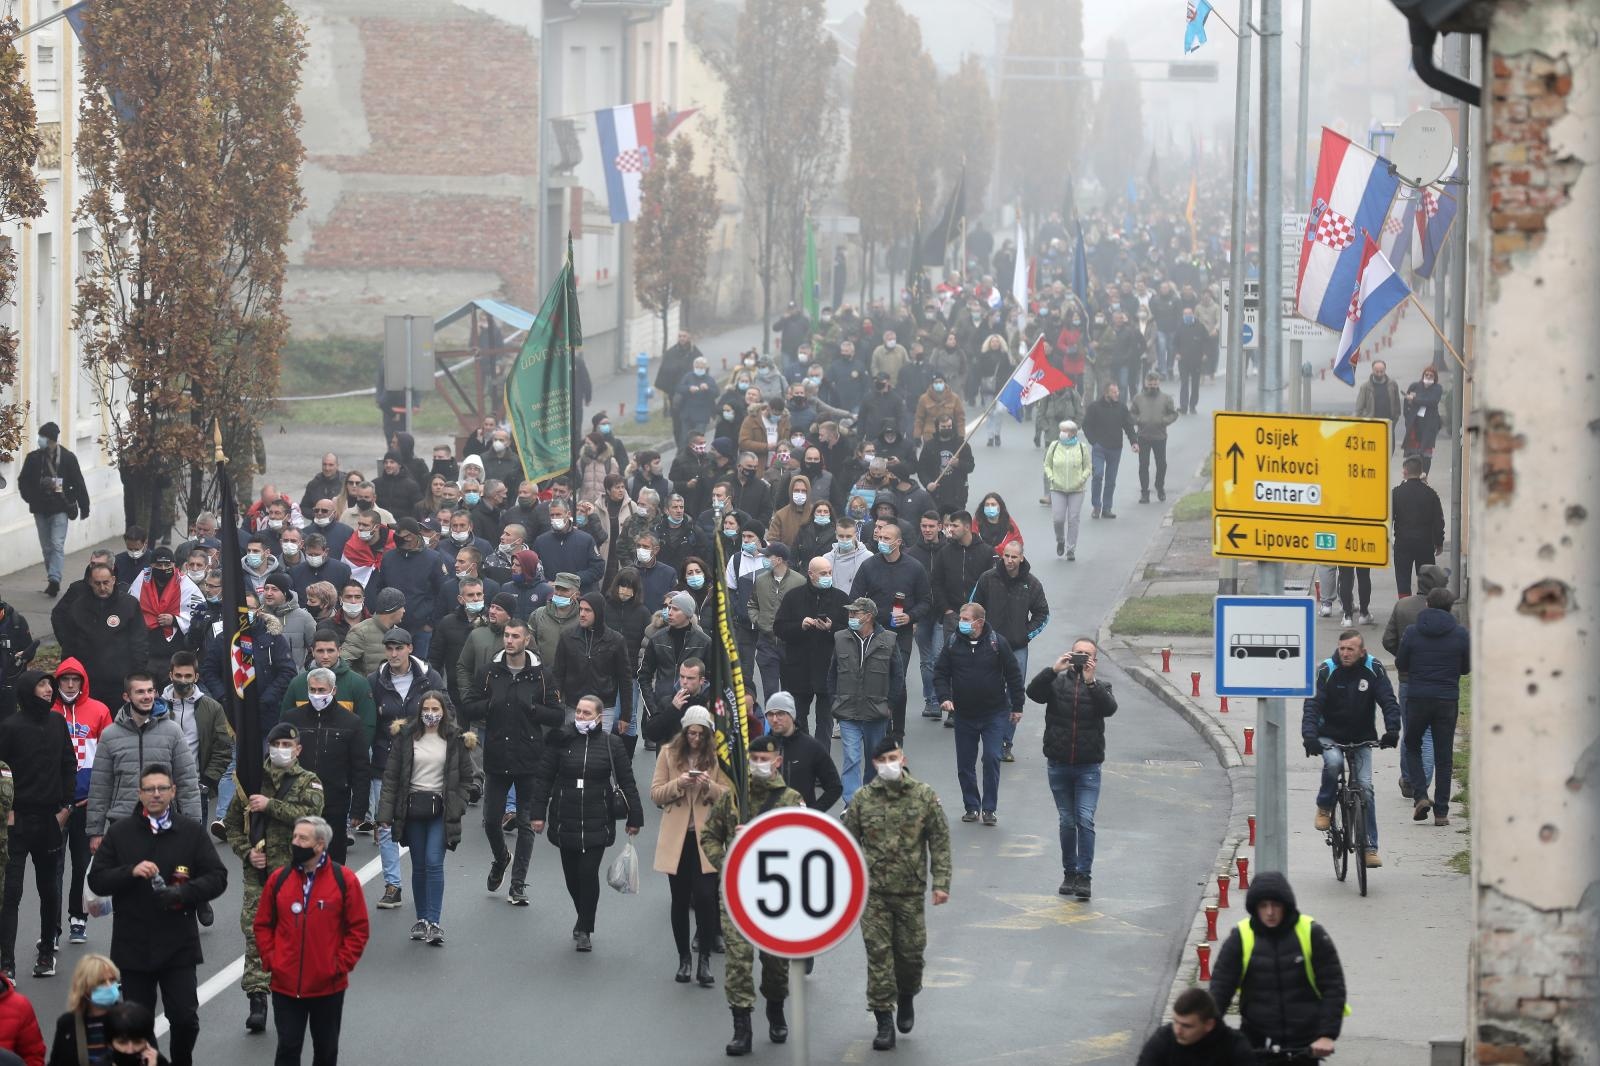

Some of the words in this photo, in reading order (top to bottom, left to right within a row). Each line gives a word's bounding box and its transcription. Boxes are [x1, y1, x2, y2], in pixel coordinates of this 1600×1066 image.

[1256, 427, 1299, 450] Osijek
[1345, 435, 1359, 451] 43
[1360, 436, 1376, 452] km
[1256, 454, 1319, 476] Vinkovci
[1348, 463, 1359, 478] 18
[1361, 463, 1376, 479] km
[1255, 482, 1304, 502] Centar
[1255, 528, 1310, 551] Lipovac
[1318, 535, 1334, 548] A3
[1345, 537, 1359, 552] 40
[1361, 538, 1376, 553] km
[756, 850, 835, 918] 50
